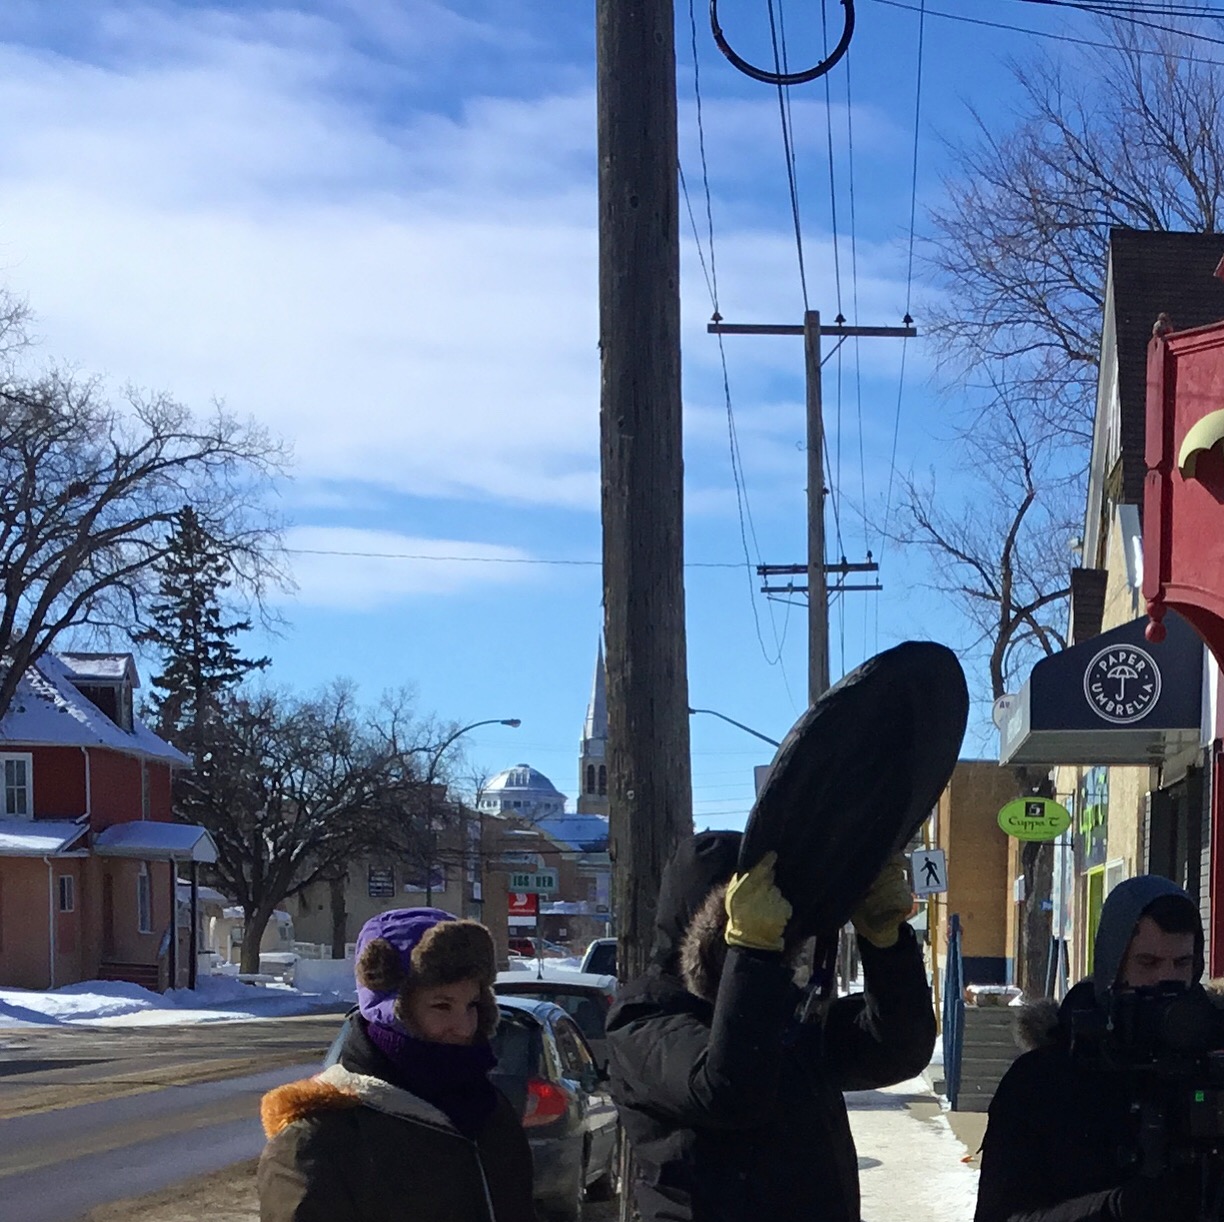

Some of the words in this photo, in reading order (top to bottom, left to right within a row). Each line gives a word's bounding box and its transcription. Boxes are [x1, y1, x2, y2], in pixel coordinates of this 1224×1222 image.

[1098, 651, 1146, 672] PAPER
[1091, 682, 1154, 716] UMBRELLA
[1008, 816, 1045, 831] Cuppa
